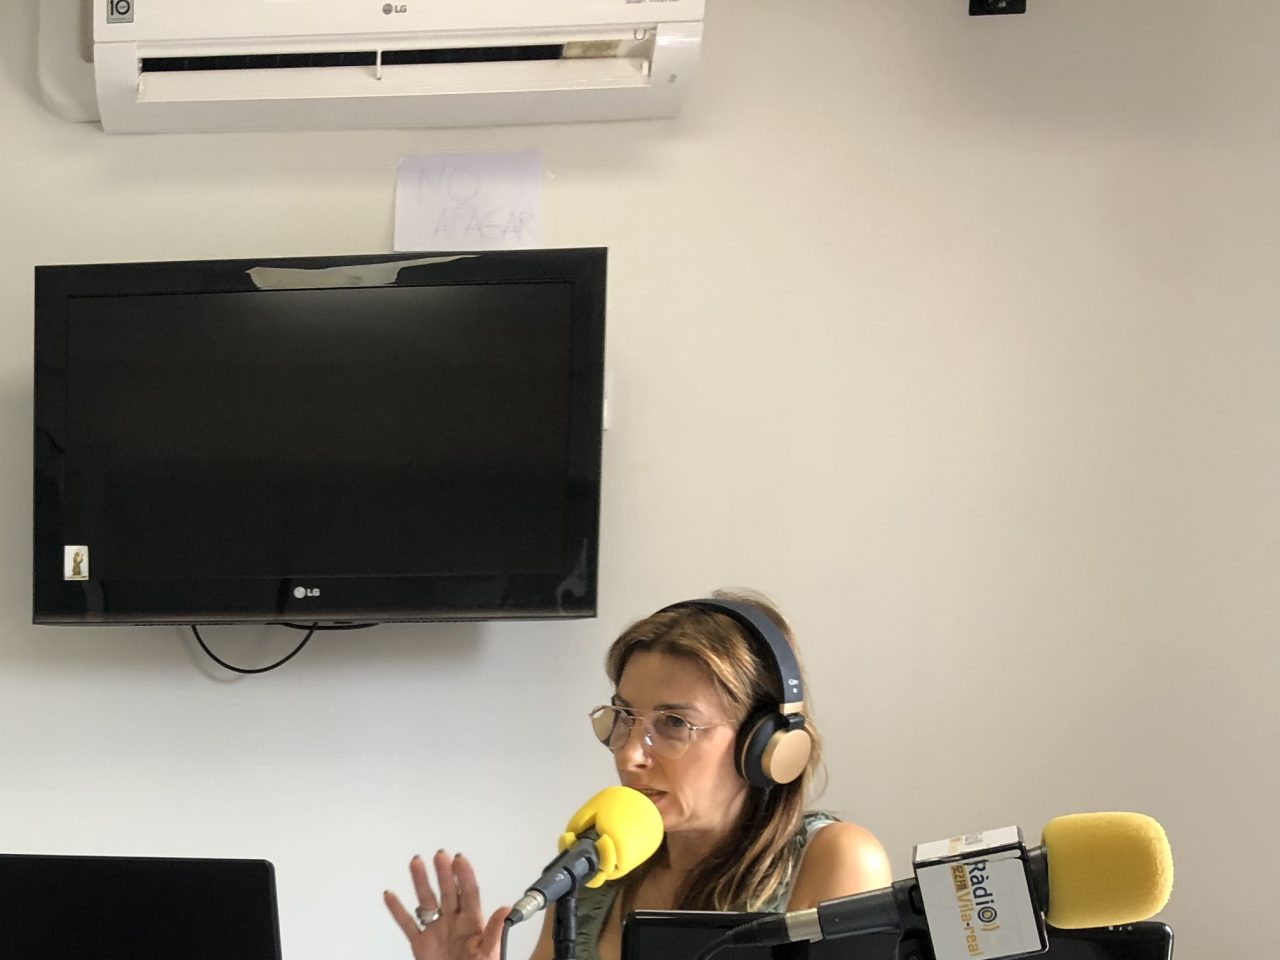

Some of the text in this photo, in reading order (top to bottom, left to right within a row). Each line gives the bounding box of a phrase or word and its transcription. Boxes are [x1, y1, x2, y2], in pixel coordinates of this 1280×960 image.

[394, 5, 407, 13] LG
[419, 164, 482, 201] NO
[433, 204, 536, 243] APAGAR
[307, 588, 320, 596] LG
